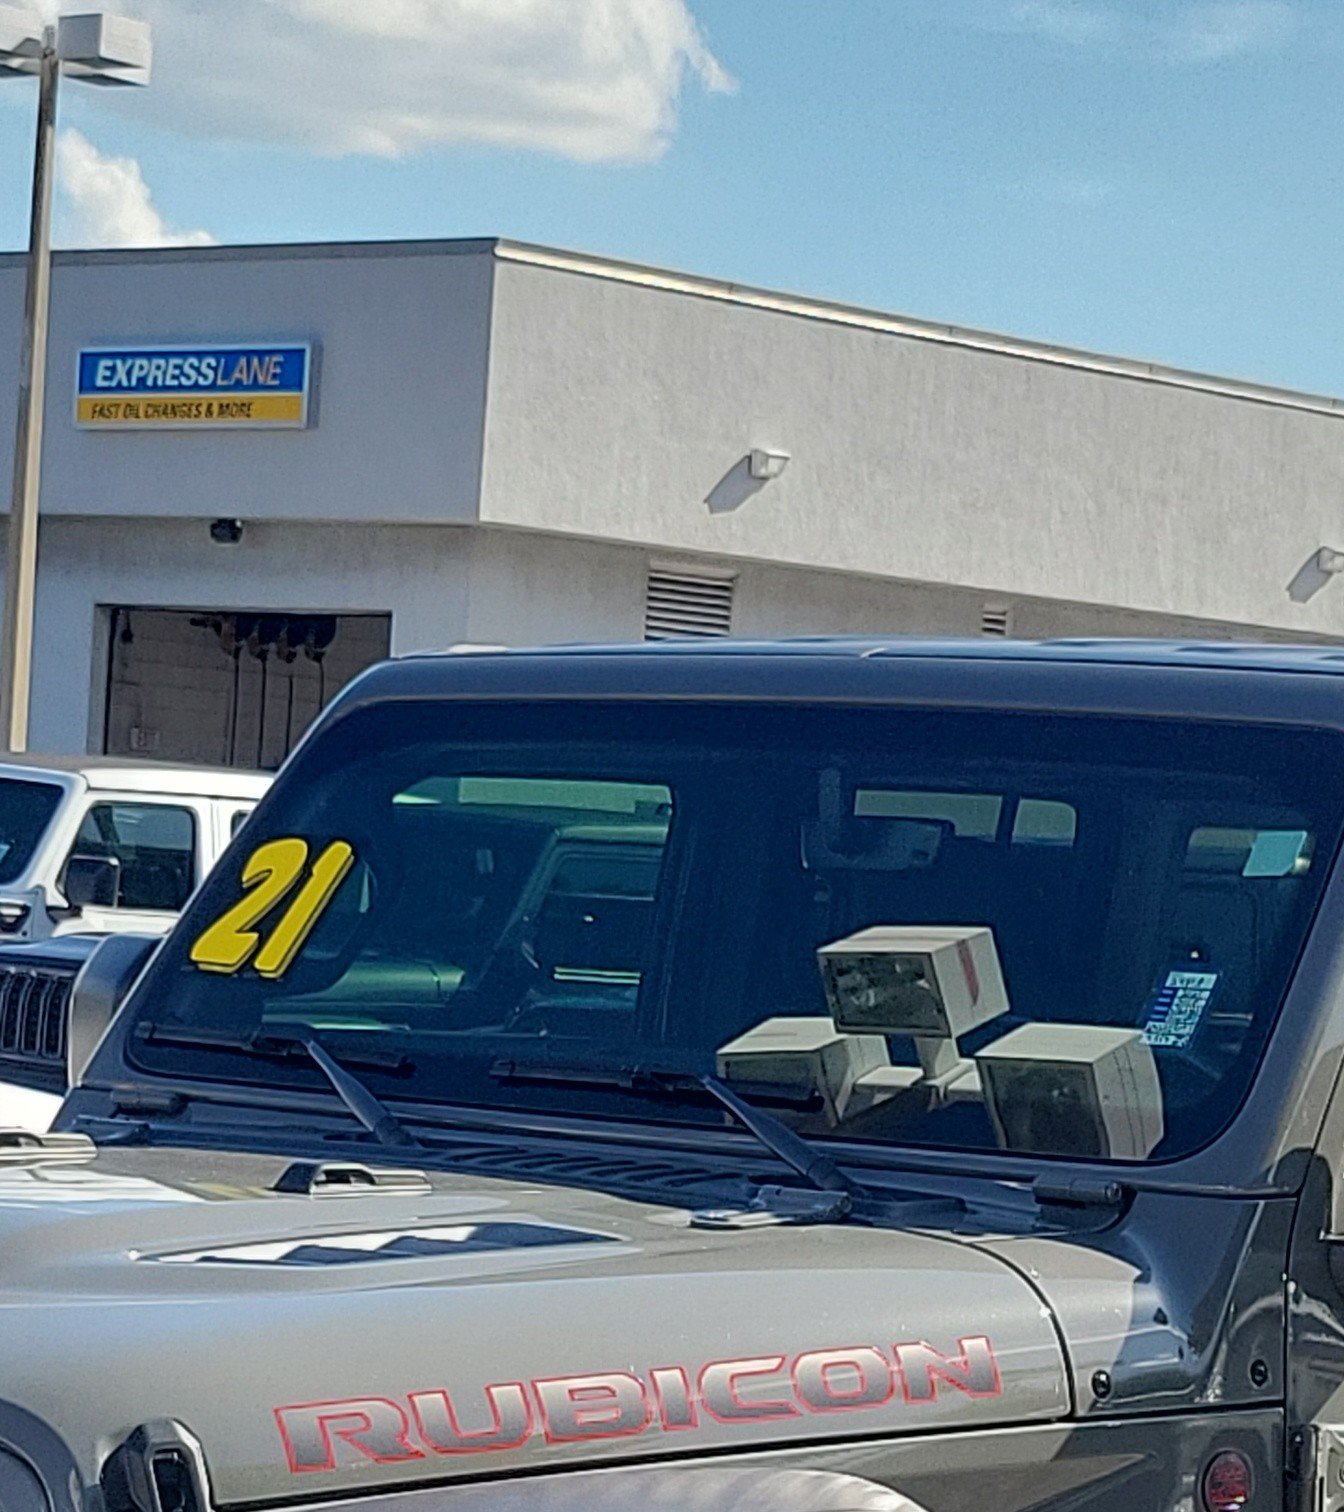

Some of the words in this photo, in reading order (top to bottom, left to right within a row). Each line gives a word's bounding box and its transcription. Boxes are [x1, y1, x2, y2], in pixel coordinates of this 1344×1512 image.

[91, 402, 121, 420] FAST
[122, 402, 141, 420] OIL
[144, 402, 202, 420] CHANGES
[204, 402, 215, 419] &
[218, 401, 253, 419] MORE
[190, 838, 354, 978] 21
[272, 1335, 1003, 1475] RUBICON
